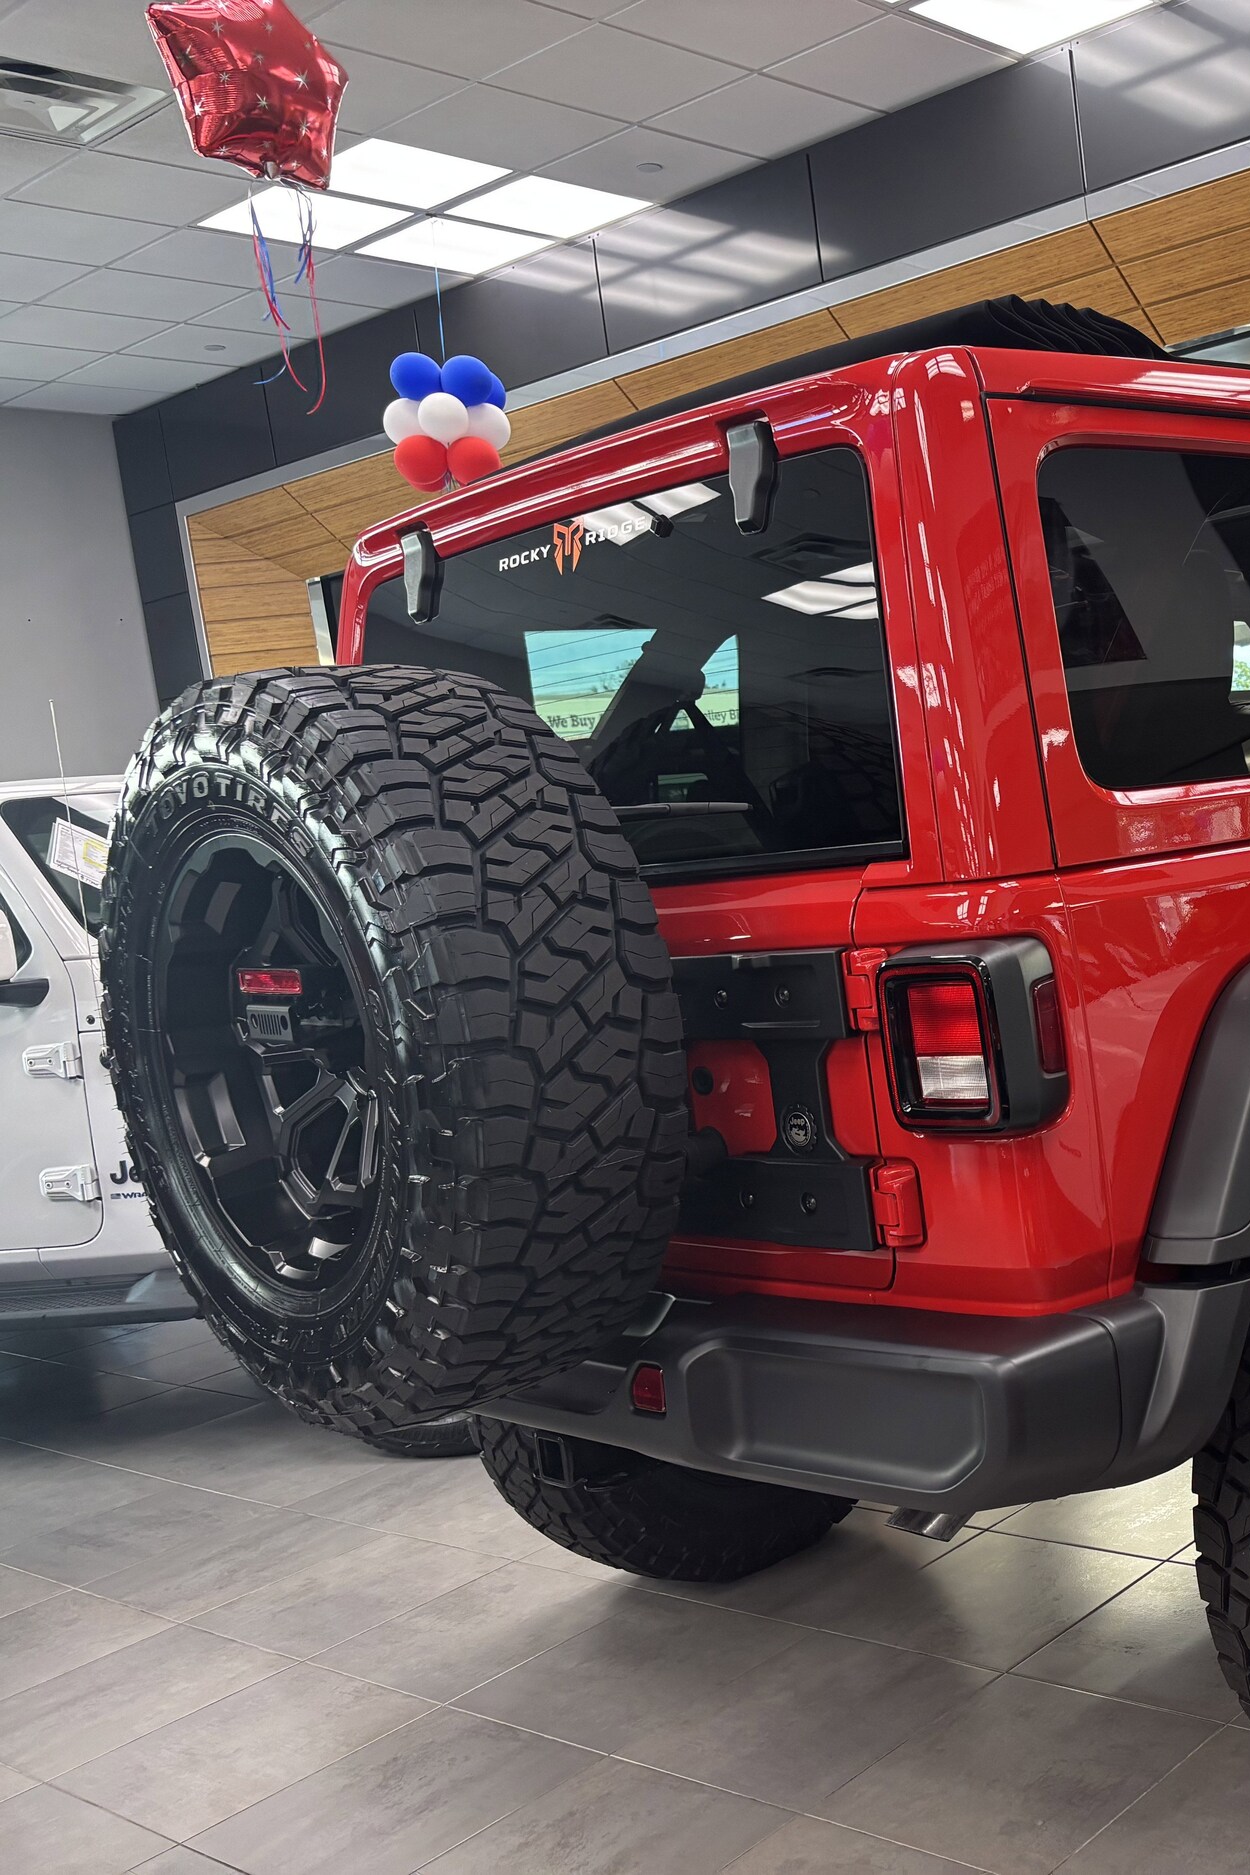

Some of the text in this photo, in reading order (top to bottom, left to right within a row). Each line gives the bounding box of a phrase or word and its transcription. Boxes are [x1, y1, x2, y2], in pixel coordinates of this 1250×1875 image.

[498, 516, 646, 572] ROCKY RIDGE
[547, 714, 596, 729] We Buy
[213, 771, 317, 858] TIRES
